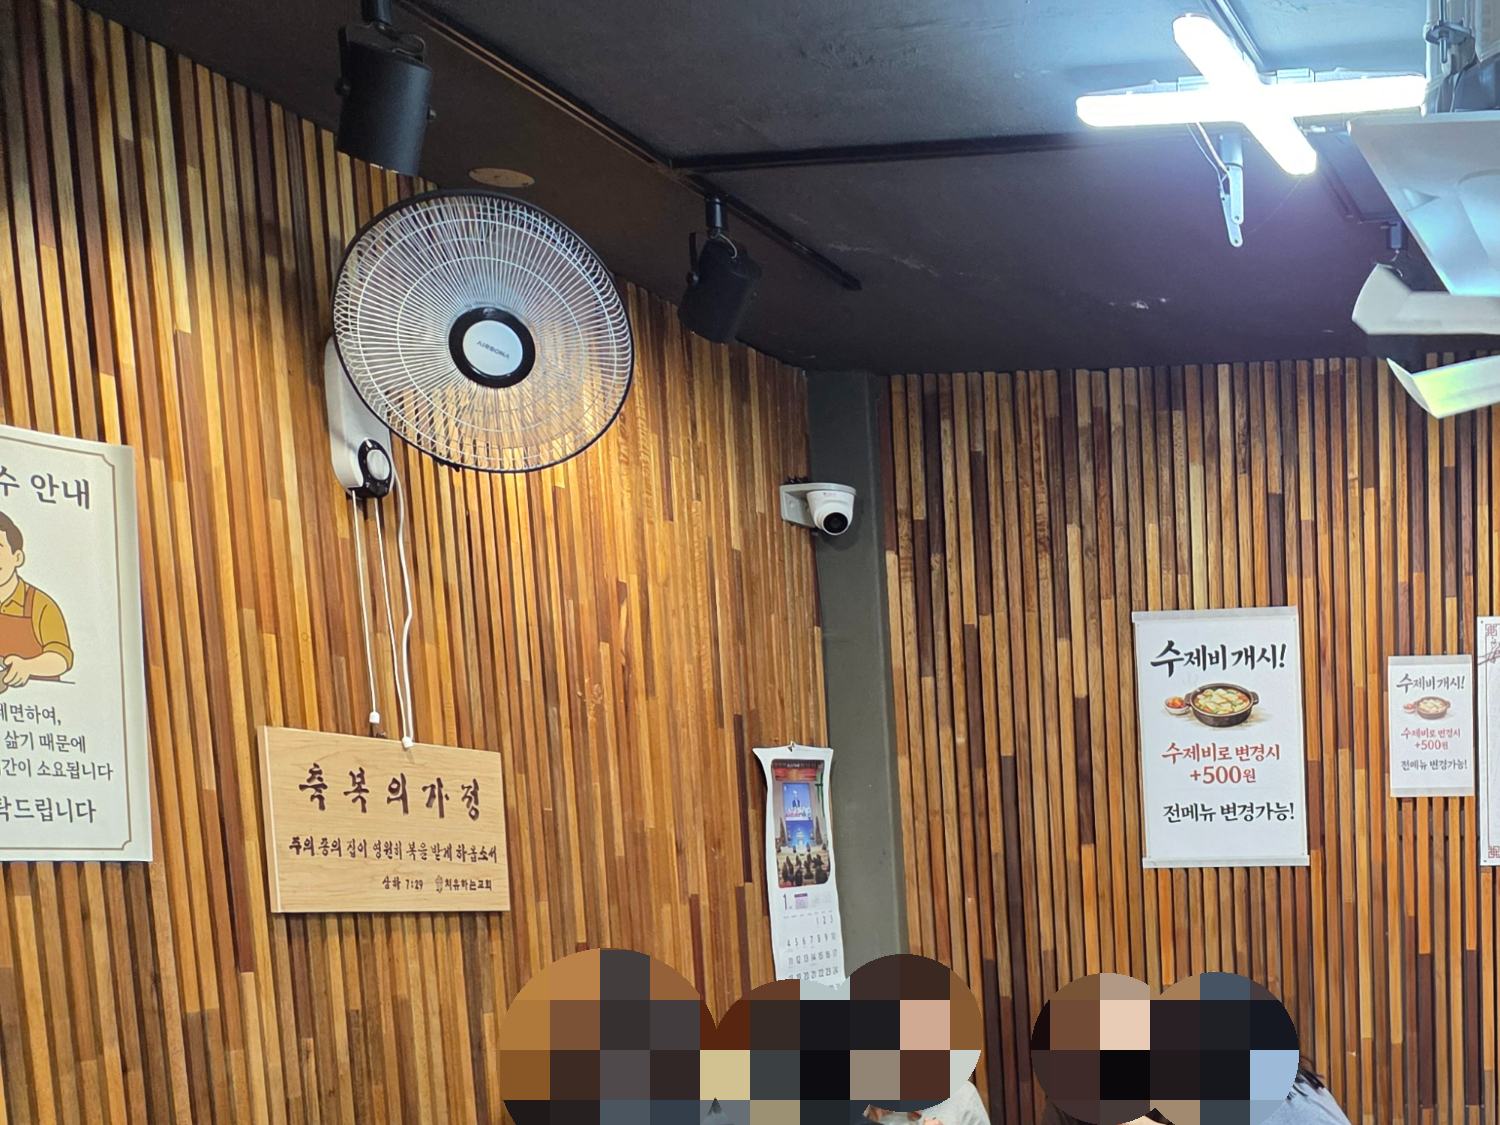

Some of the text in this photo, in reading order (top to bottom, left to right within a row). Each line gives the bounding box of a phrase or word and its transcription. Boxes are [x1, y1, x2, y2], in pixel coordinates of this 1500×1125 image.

[30, 473, 90, 510] 안내
[1150, 640, 1287, 678] 수제비 개시!
[1396, 673, 1466, 694] 수제비 개시!
[5, 730, 86, 754] 삶기 때문에
[1401, 727, 1437, 740] 수제비로
[1162, 742, 1280, 764] 수제비로 변경시
[1415, 739, 1449, 750] +500원
[0, 757, 114, 781] 간이 소요됩니다
[1190, 765, 1257, 784] +500원
[1401, 760, 1428, 771] 전메뉴
[1163, 802, 1295, 823] 전메뉴 변경가능!
[289, 836, 315, 857] 주의
[318, 837, 342, 858] 종의
[346, 838, 368, 858] 집이
[372, 840, 402, 860] 영원히
[406, 841, 428, 861] 복을
[456, 844, 498, 864] 하옵소서
[405, 879, 424, 890] 7:29
